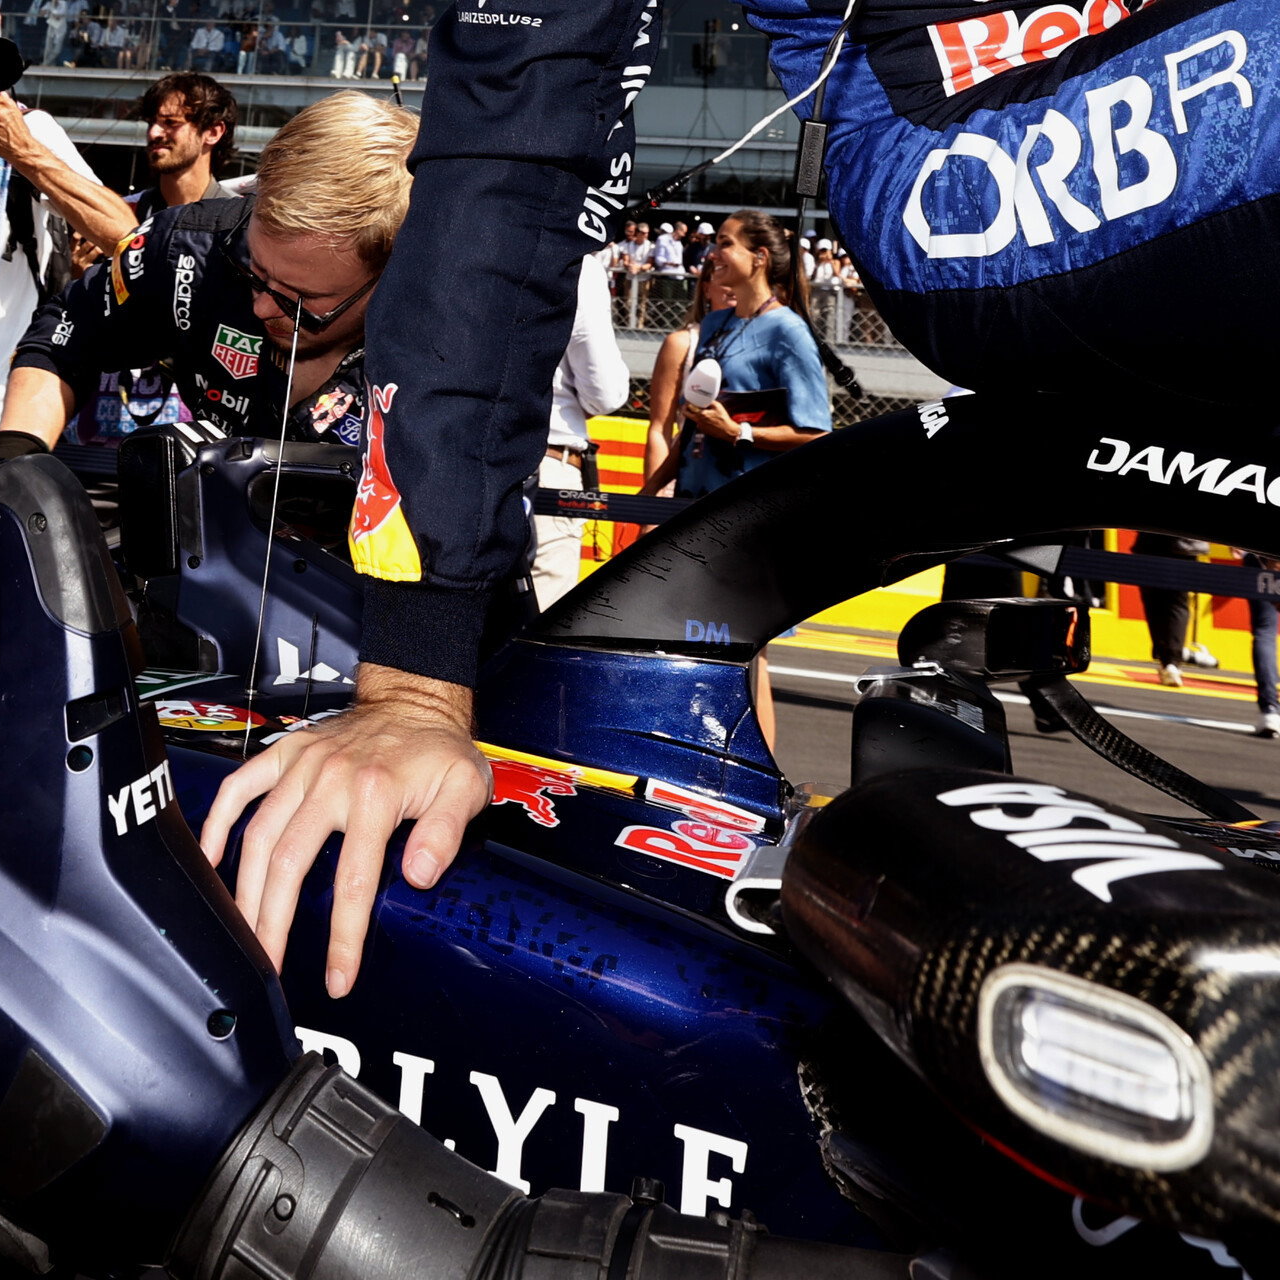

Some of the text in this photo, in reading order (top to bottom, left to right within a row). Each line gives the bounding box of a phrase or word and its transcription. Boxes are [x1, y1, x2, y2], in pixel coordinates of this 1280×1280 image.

[174, 253, 196, 331] sparco
[215, 345, 258, 380] HEUE
[195, 372, 250, 416] Mobil
[559, 490, 608, 501] ORACLE
[685, 620, 731, 646] DM
